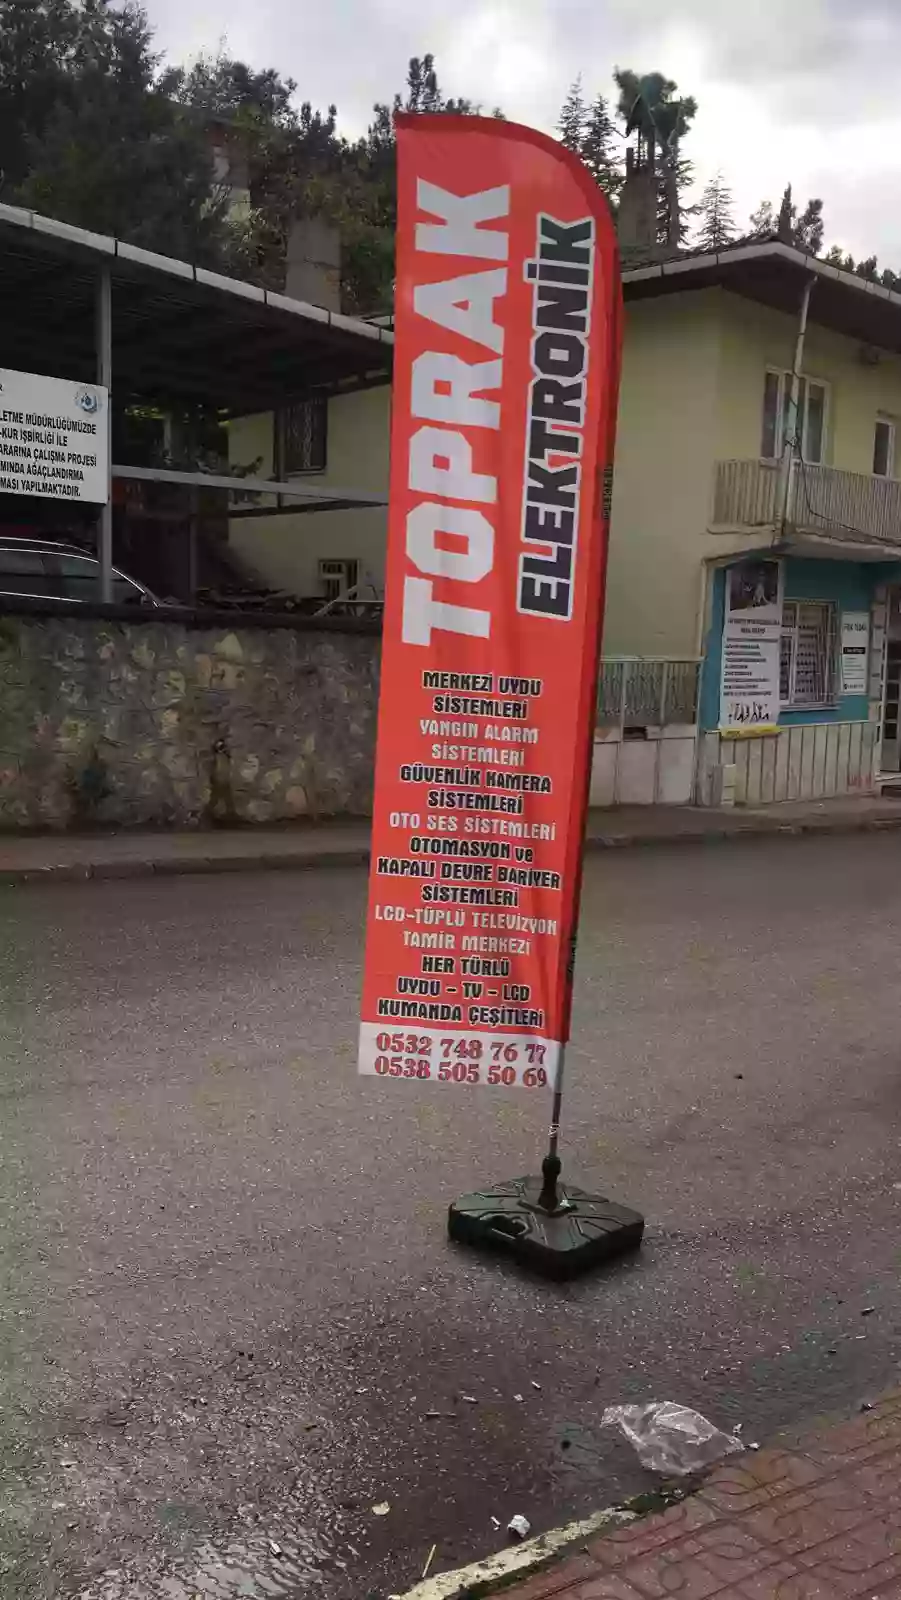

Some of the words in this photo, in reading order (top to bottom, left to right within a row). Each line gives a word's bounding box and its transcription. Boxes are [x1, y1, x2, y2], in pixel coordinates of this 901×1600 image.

[402, 176, 511, 647] TOPRAK
[516, 212, 595, 621] ELEKTRONİK
[57, 431, 68, 446] İLE
[34, 449, 65, 464] ÇALIŞMA
[68, 452, 97, 467] PROJESİ
[27, 463, 84, 481] AĞAÇLANDIRMA
[423, 671, 493, 692] MERKEZİ
[499, 677, 543, 696] UYDU
[433, 694, 528, 719] SİSTEMLERİ
[420, 719, 478, 738] YANGIN
[484, 724, 539, 743] ALARM
[431, 741, 525, 766] SİSTEMLERİ
[400, 762, 481, 786] GÜVENLİK
[485, 770, 552, 793] KAMERA
[428, 789, 524, 815] SİSTEMLERİ
[389, 812, 420, 829] OTO
[427, 816, 458, 832] SES
[464, 815, 556, 841] SİSTEMLERİ
[409, 836, 510, 859] OTOMASYON
[515, 847, 534, 863] ve
[377, 857, 435, 878] KAPALI
[440, 862, 492, 882] DEVRE
[496, 867, 561, 890] BARİYER
[421, 883, 519, 907] SİSTEMLERİ
[375, 904, 466, 927] LCD-TÜPLÜ
[472, 911, 557, 936] TELEVİZYON
[403, 930, 456, 949] TAMİR
[462, 937, 532, 956] MERKEZİ
[421, 955, 454, 974] HER
[460, 955, 511, 977] TÜRLÜ
[397, 976, 441, 997] UYDU
[462, 982, 482, 1000] TV
[503, 984, 530, 1002] LCD
[377, 999, 462, 1021] KUMANDA
[468, 1005, 544, 1029] ÇEŞİTLERİ
[376, 1032, 433, 1057] 0532
[439, 1038, 483, 1059] 748
[490, 1042, 518, 1062] 76
[525, 1043, 546, 1065] 77
[374, 1055, 431, 1079] 0538
[438, 1062, 480, 1084] 505
[487, 1066, 516, 1086] 50
[523, 1068, 548, 1088] 69
